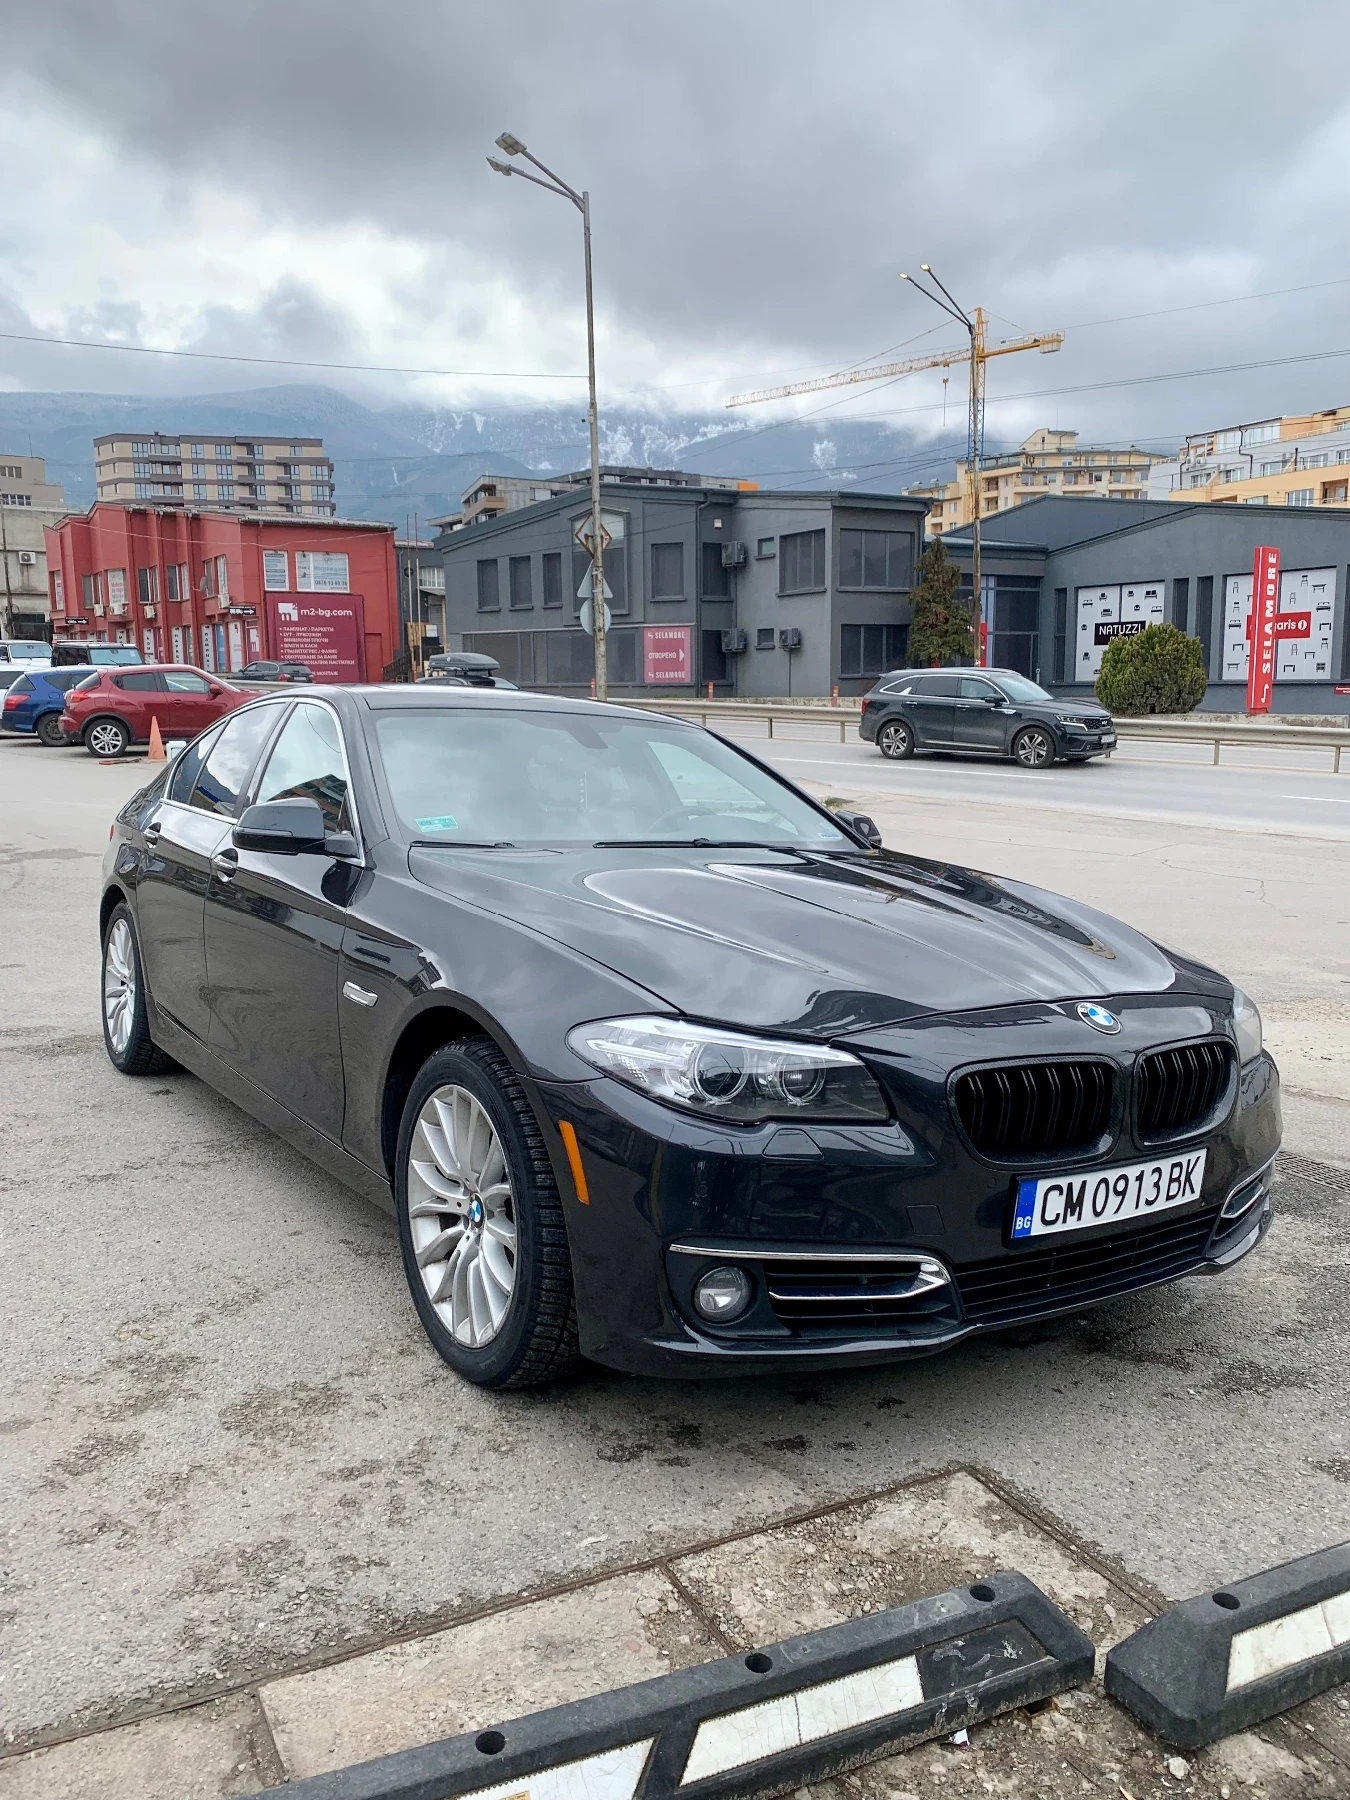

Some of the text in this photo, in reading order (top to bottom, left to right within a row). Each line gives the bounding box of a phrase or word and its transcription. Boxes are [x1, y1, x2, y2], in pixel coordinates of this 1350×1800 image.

[300, 608, 353, 617] m2-bg.com
[1262, 552, 1277, 674] SELAMORE
[655, 631, 685, 639] SELAMORE
[1099, 624, 1141, 636] NATUZZI
[655, 671, 686, 679] SELAMORE
[1015, 1215, 1032, 1230] BG
